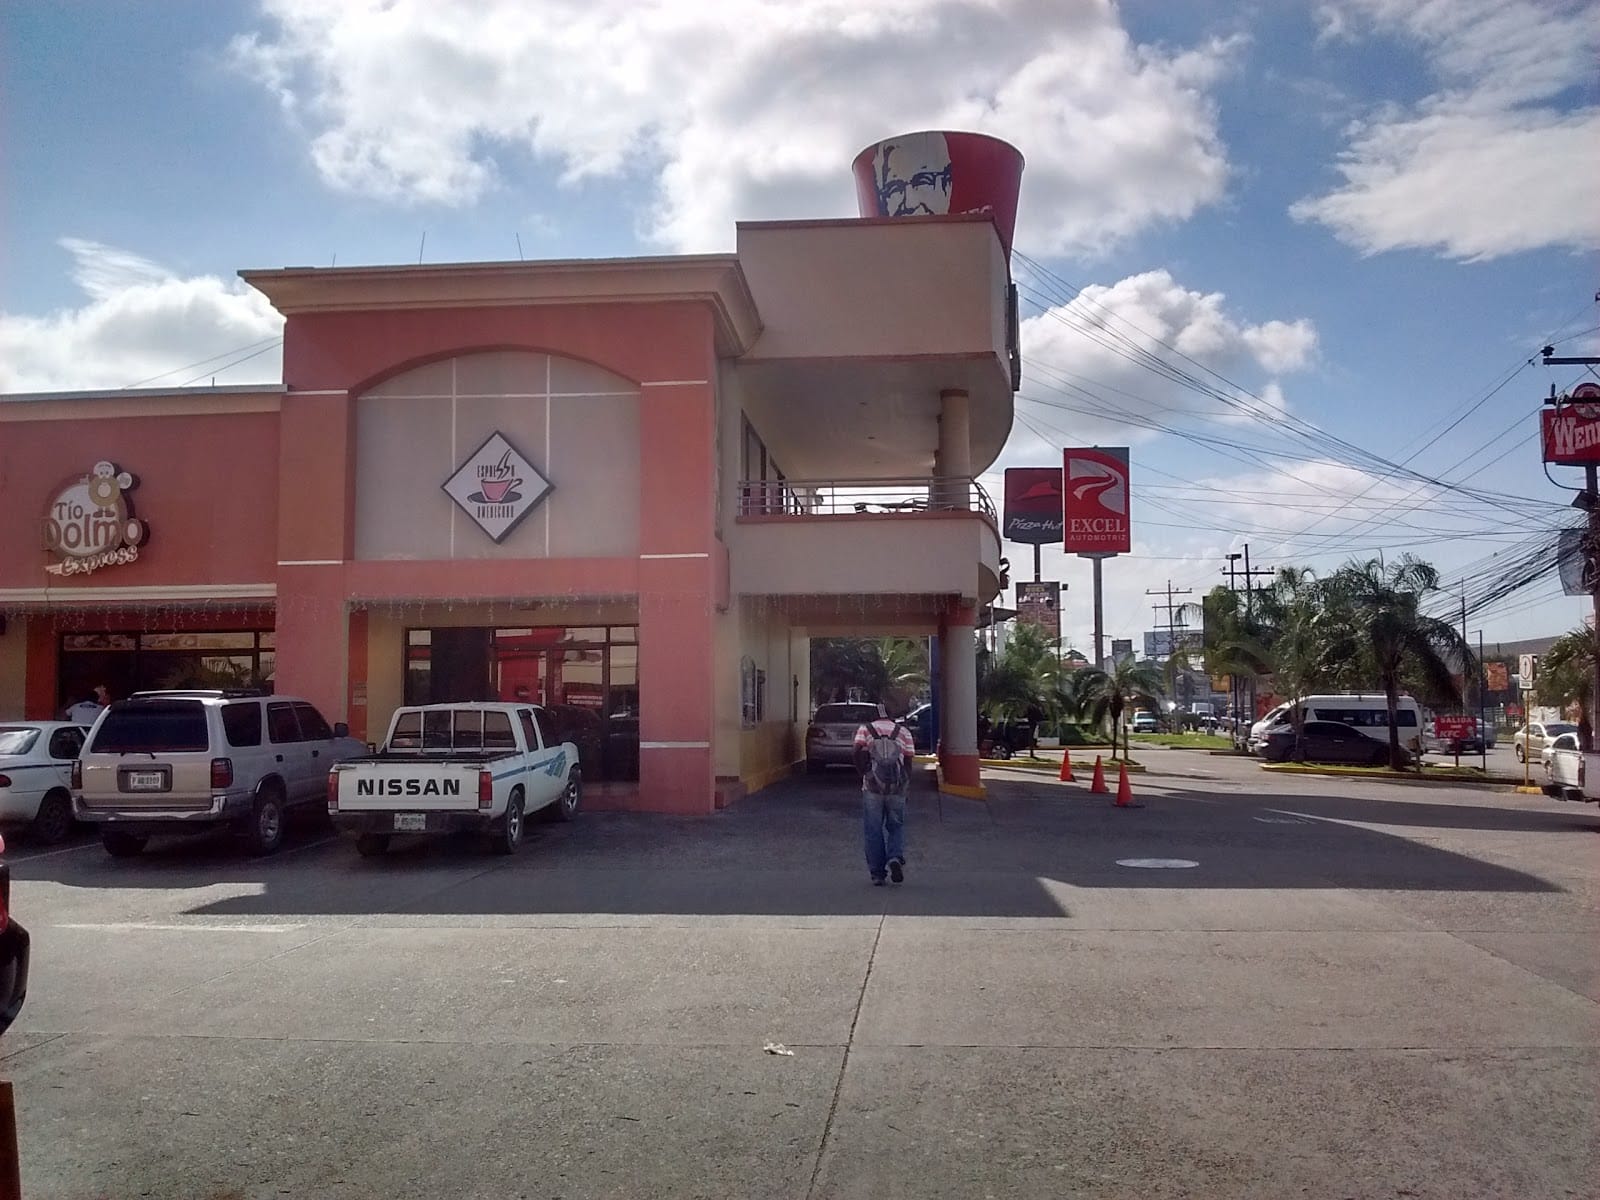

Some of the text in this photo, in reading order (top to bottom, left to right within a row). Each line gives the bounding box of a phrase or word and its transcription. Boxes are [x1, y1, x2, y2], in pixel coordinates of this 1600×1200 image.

[1008, 518, 1041, 530] Pizza
[1070, 518, 1126, 532] EXCEL
[1439, 730, 1461, 738] KFC
[357, 779, 460, 796] NISSAN
